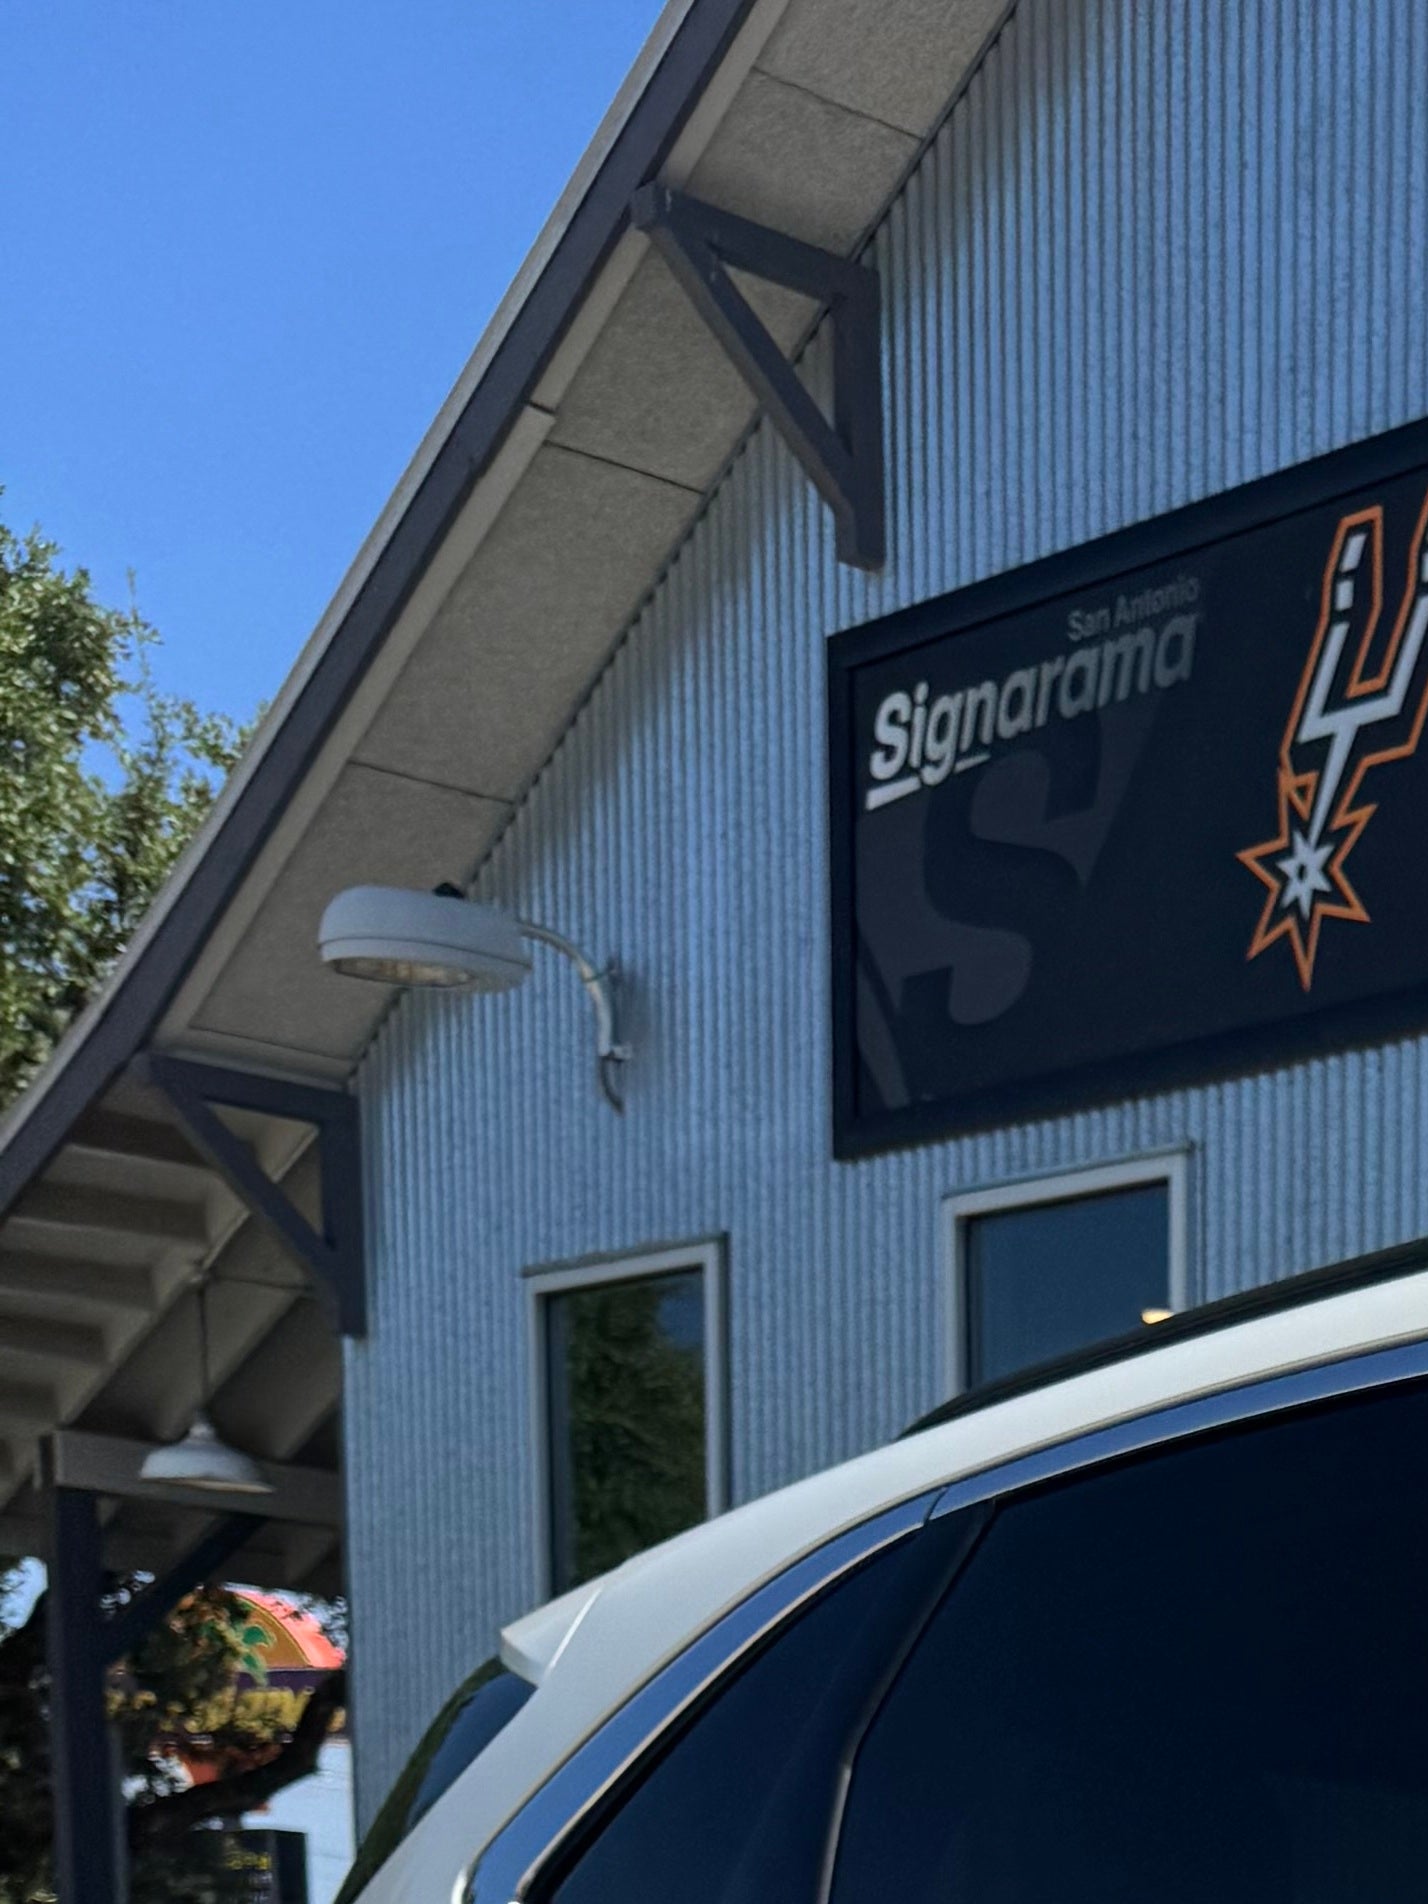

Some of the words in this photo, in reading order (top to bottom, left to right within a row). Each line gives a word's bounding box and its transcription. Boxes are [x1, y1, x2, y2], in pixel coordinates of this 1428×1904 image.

[1067, 603, 1111, 642] San
[1113, 574, 1201, 628] Antonio
[868, 612, 1201, 788] Signarama
